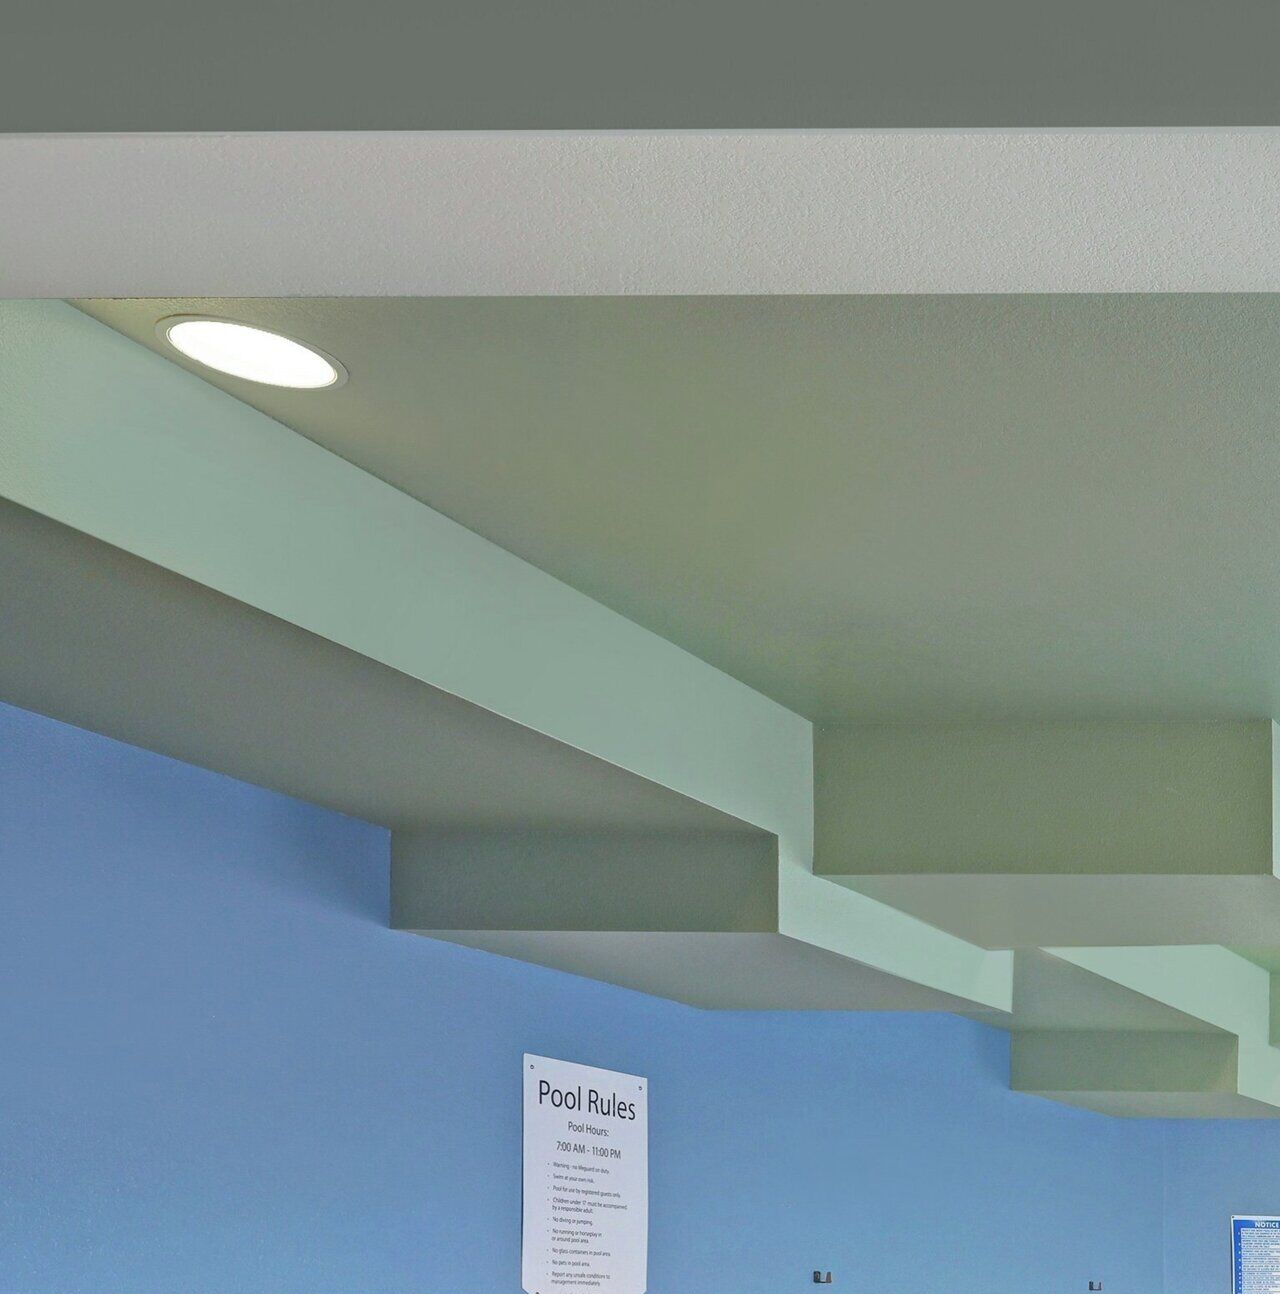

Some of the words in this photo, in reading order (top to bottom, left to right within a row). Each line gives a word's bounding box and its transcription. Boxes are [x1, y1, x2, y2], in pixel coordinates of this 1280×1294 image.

[538, 1079, 581, 1111] Pool
[587, 1089, 636, 1121] Rules
[567, 1121, 584, 1133] Pool
[586, 1124, 609, 1137] Hours:
[556, 1141, 572, 1152] 7:00
[573, 1144, 586, 1154] AM
[592, 1146, 609, 1158] 11:00
[610, 1149, 621, 1159] PM
